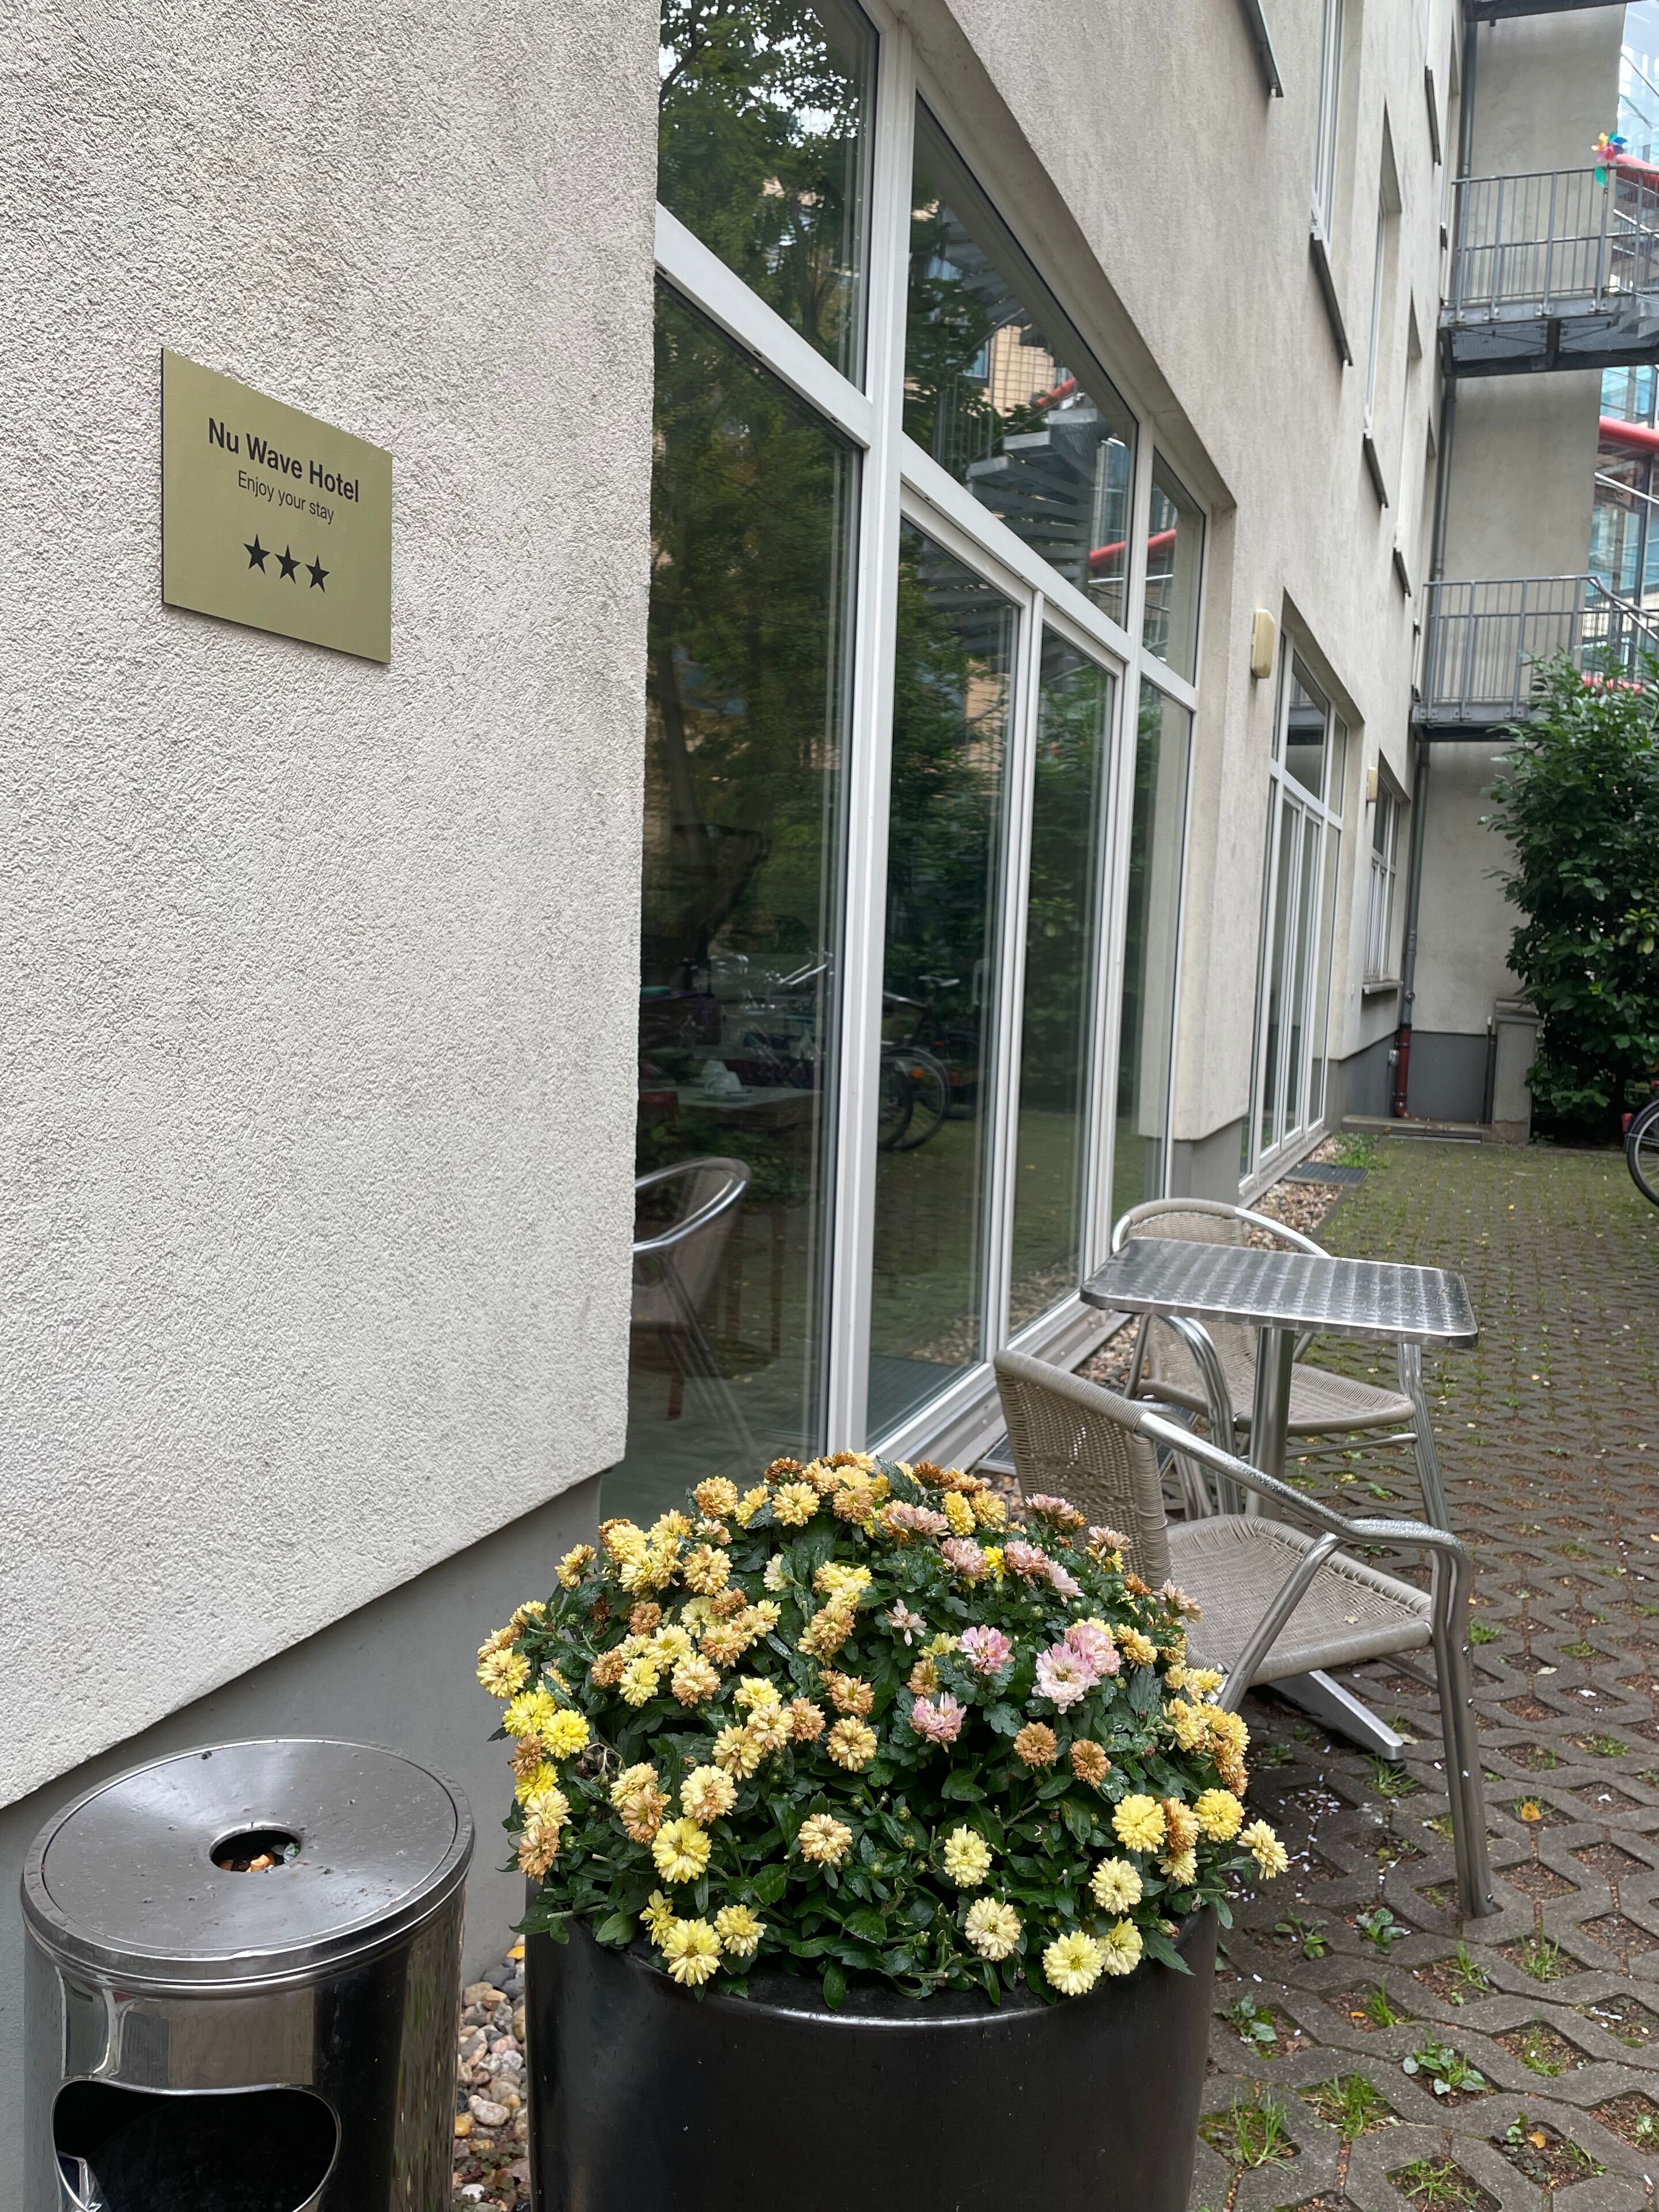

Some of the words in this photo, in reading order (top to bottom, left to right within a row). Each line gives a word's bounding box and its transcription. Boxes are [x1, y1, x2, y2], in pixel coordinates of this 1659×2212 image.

[209, 418, 239, 454] Nu
[246, 433, 303, 479] Wave
[309, 460, 359, 502] Hotel
[238, 470, 275, 502] Enjoy
[278, 490, 306, 511] your
[309, 502, 335, 525] stay
